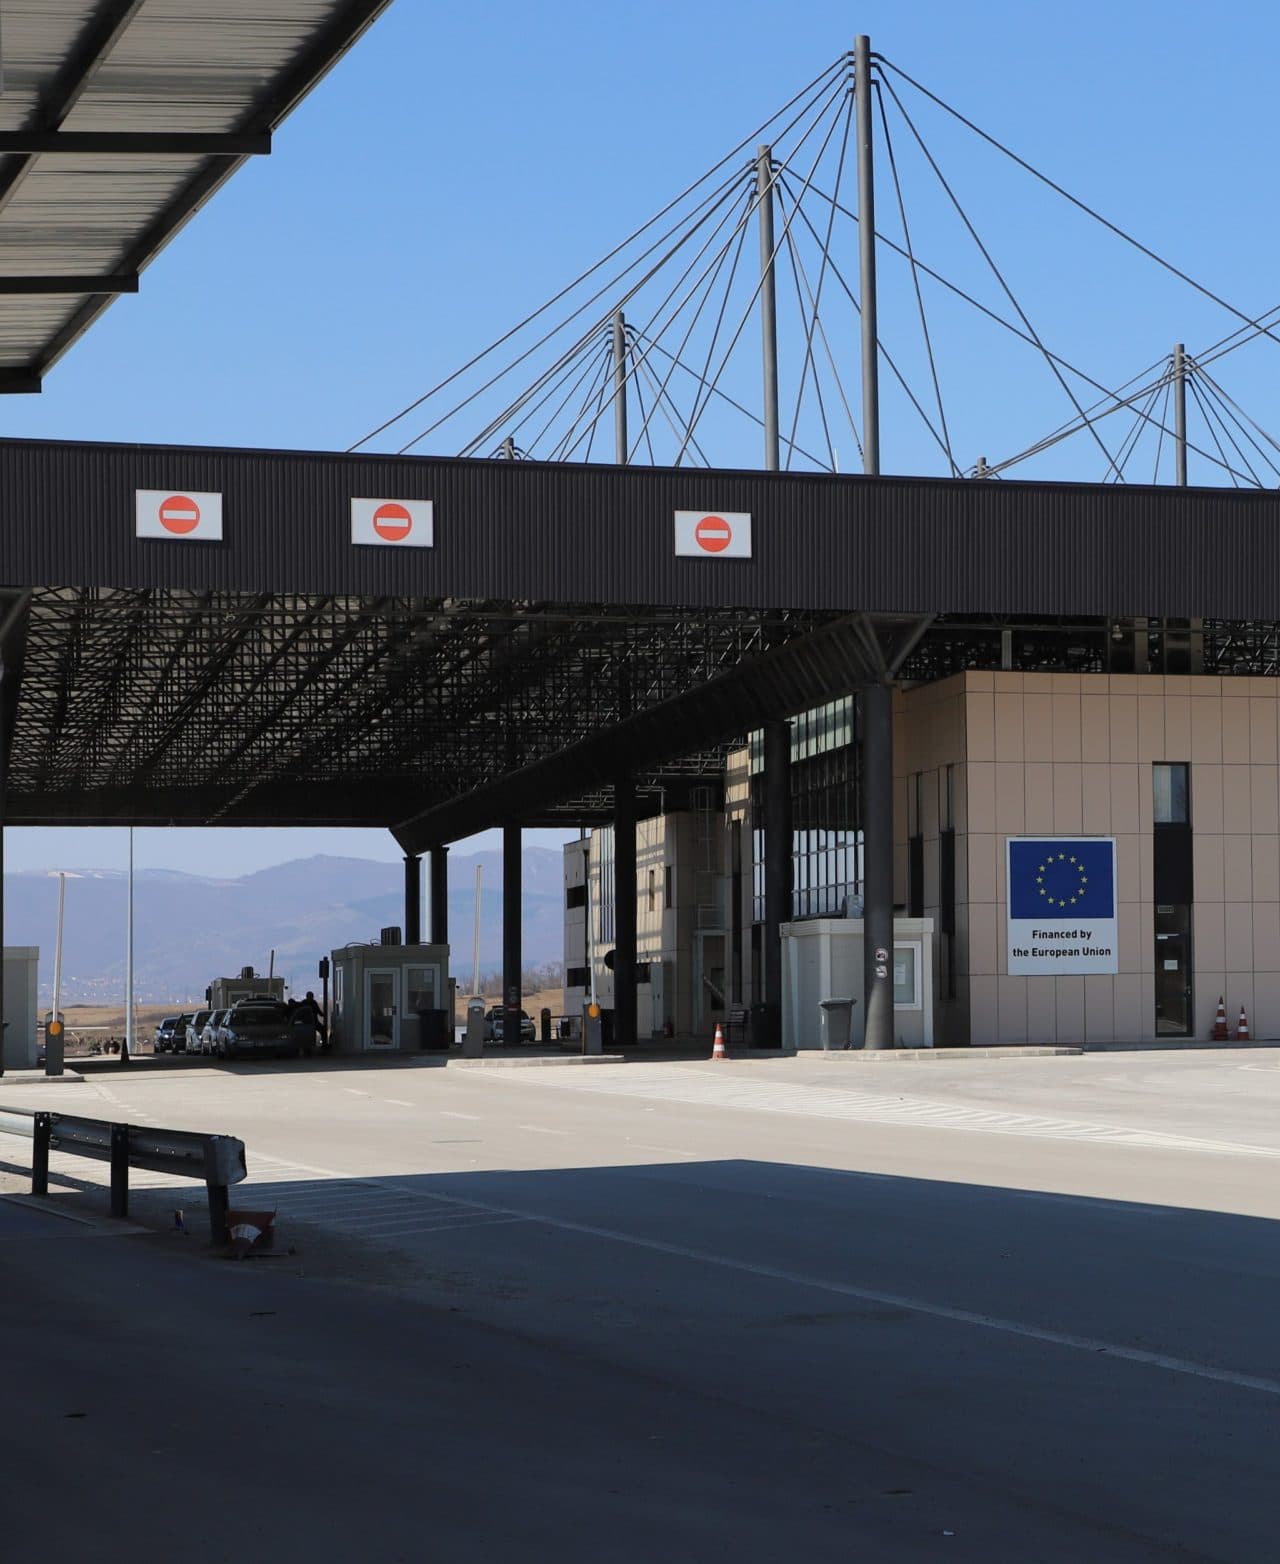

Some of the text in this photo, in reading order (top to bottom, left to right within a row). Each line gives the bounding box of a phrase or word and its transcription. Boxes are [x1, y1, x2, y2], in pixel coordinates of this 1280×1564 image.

[1032, 929, 1092, 940] Financed by
[1013, 946, 1111, 958] the European Union
